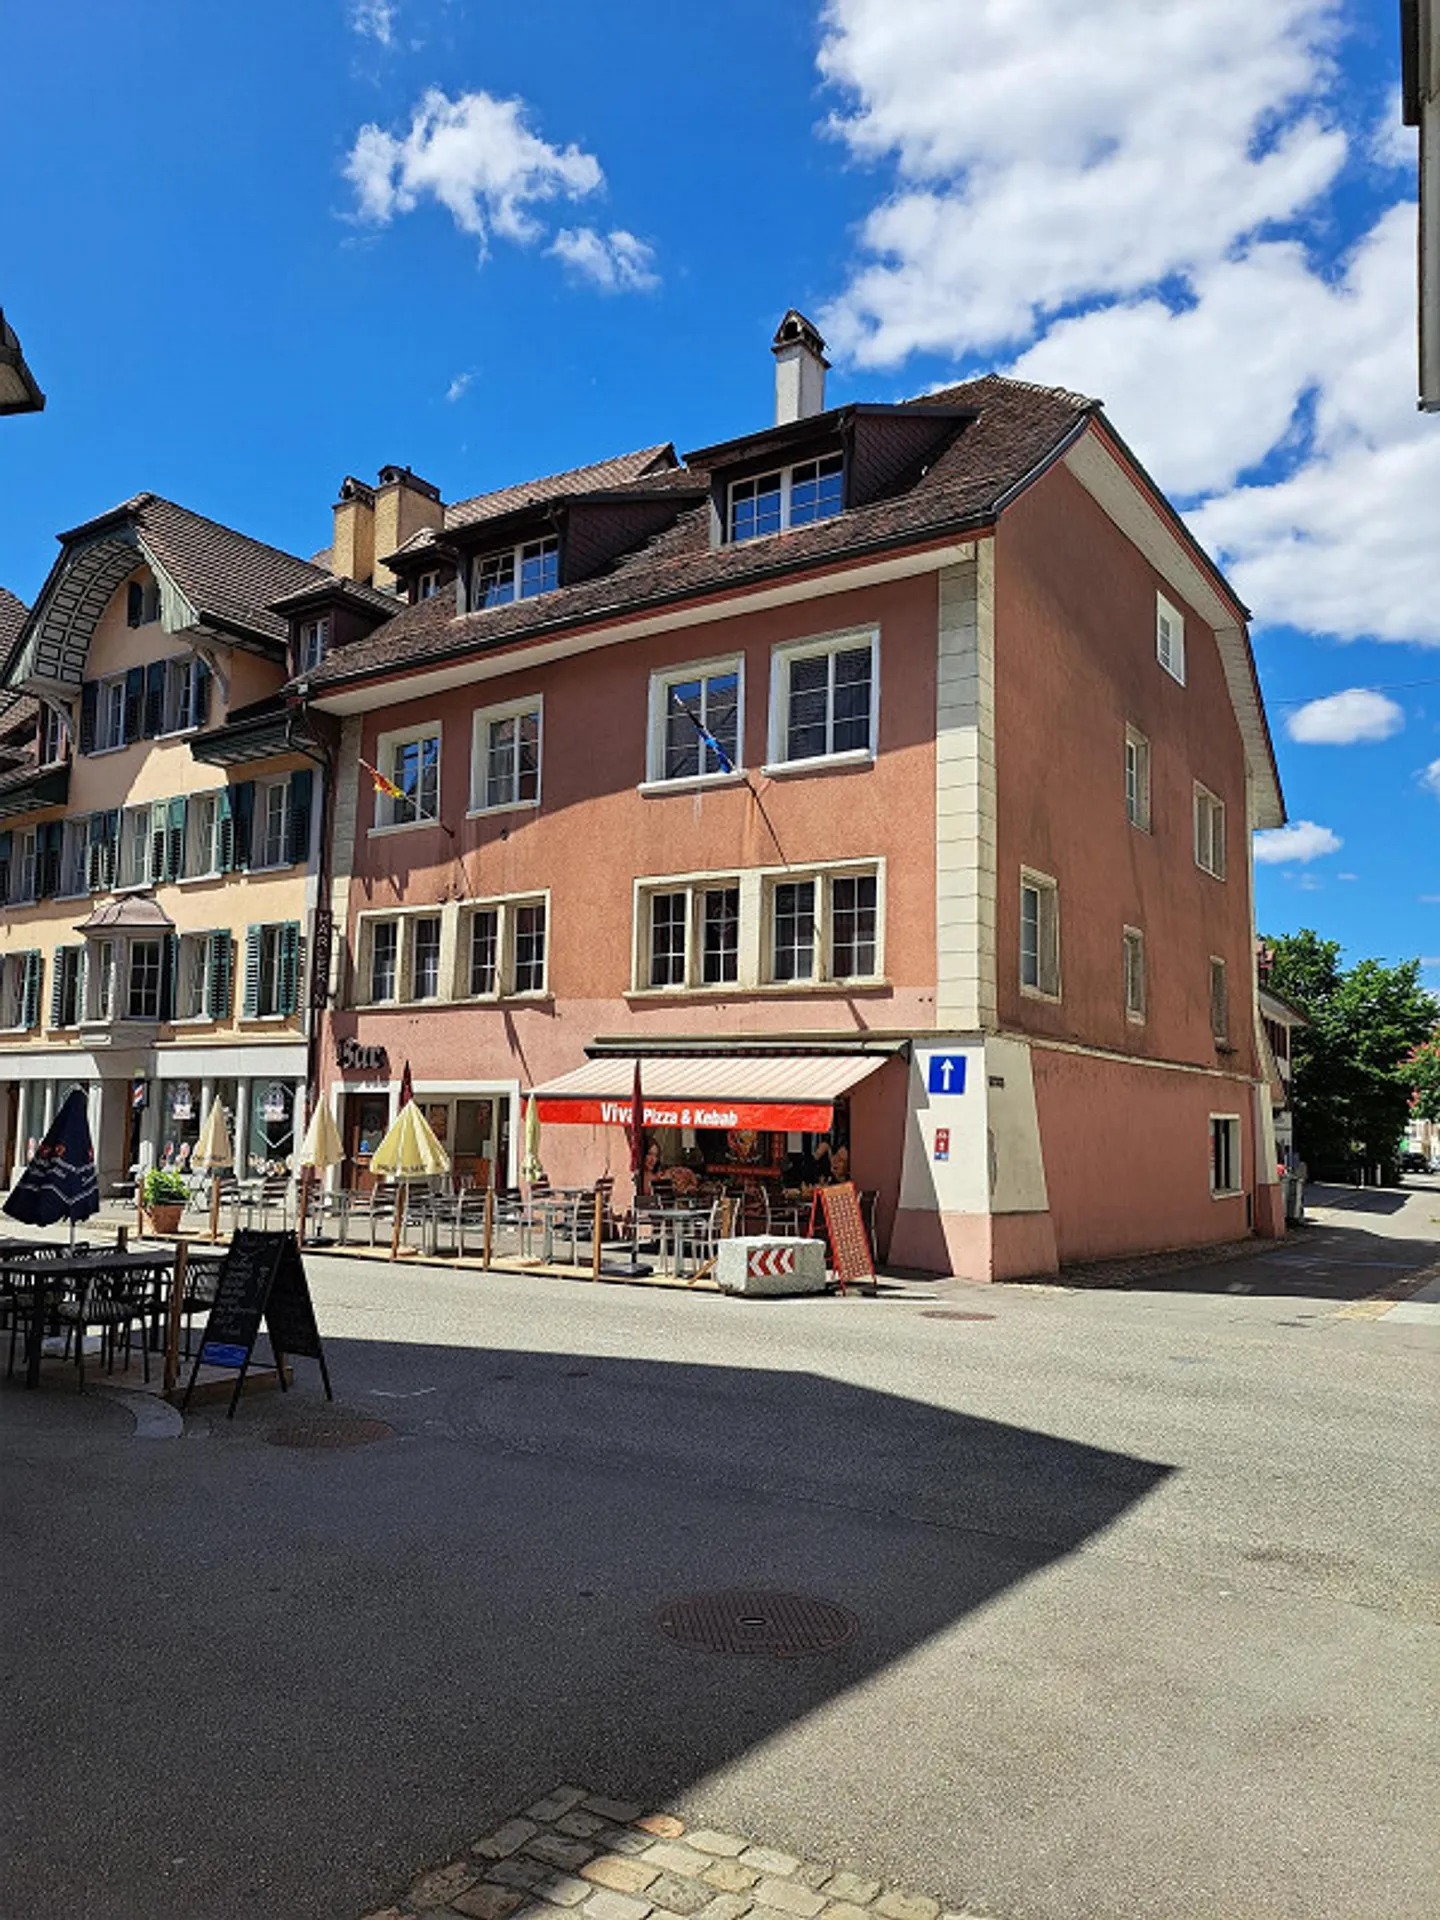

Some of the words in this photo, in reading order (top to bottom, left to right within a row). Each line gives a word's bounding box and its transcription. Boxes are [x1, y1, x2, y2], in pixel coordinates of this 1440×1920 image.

[643, 1108, 678, 1125] Pizza
[681, 1108, 692, 1125] &
[694, 1109, 738, 1127] Kebab
